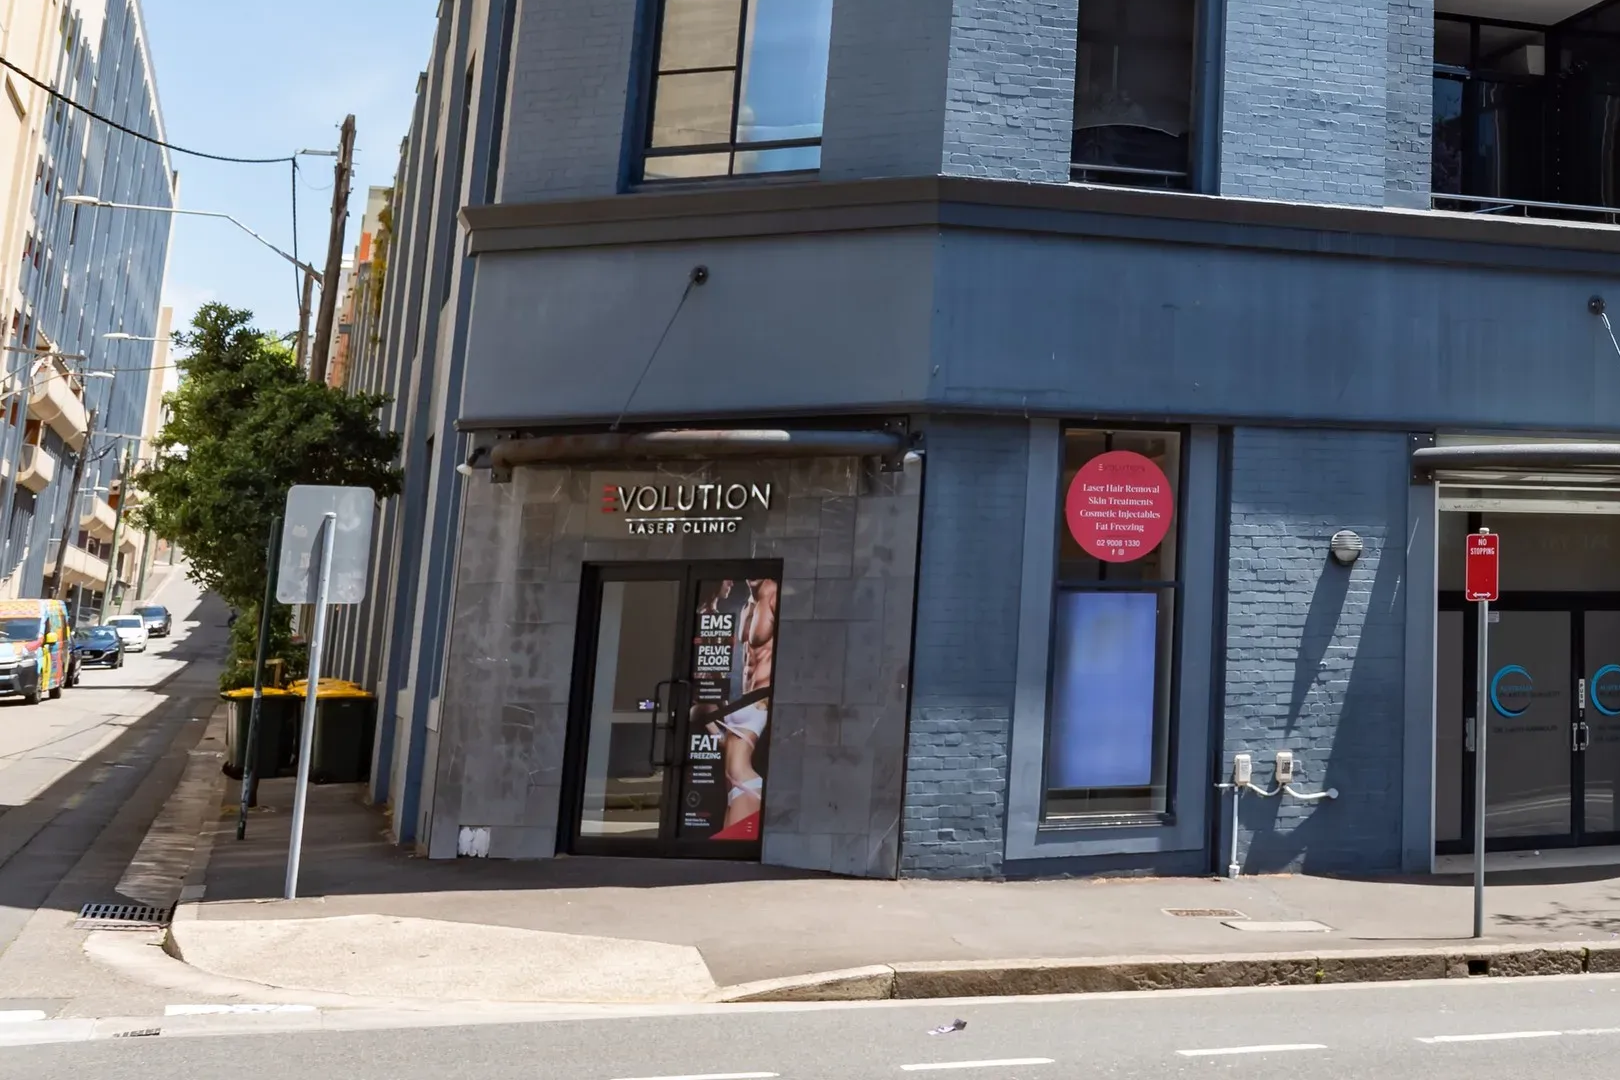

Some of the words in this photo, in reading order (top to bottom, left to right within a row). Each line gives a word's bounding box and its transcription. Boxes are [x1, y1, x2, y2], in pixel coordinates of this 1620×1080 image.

[1083, 483, 1105, 492] Laser
[1106, 484, 1124, 492] Hair
[1125, 484, 1160, 493] Removal
[602, 483, 771, 512] EVOLUTION
[1088, 496, 1107, 505] Skin
[1108, 497, 1154, 506] Treatments
[1080, 509, 1117, 518] Cosmetic
[1118, 509, 1161, 520] Injectables
[628, 522, 675, 534] LASER
[682, 521, 737, 534] CLINIC
[1095, 522, 1108, 531] Fat
[1110, 523, 1144, 532] Freezing
[1096, 539, 1105, 547] 02
[1478, 538, 1487, 546] NO
[1470, 547, 1495, 555] STOPPING
[700, 614, 733, 630] EMS
[698, 645, 731, 656] PELVIC
[697, 655, 730, 666] FLOOR
[690, 734, 721, 751] FAT
[690, 752, 721, 760] FREEZING
